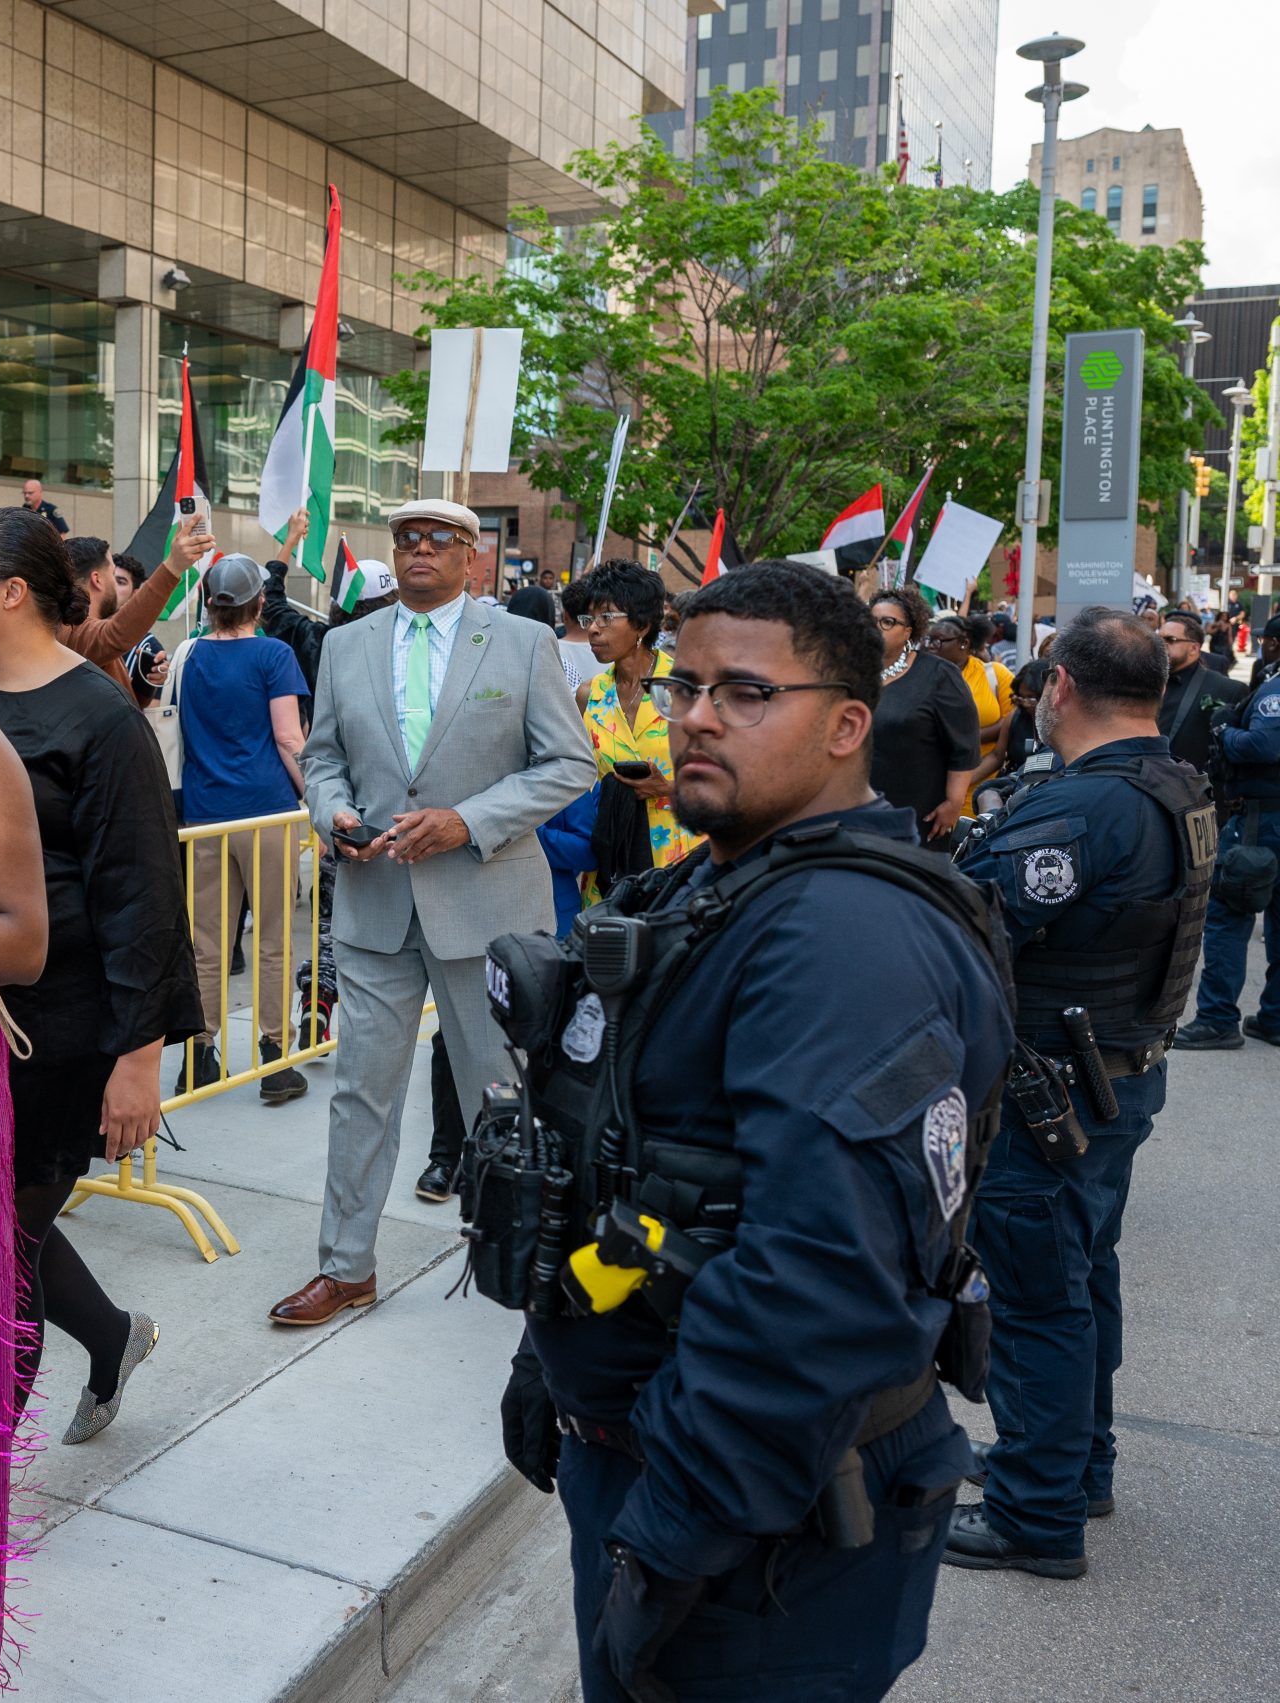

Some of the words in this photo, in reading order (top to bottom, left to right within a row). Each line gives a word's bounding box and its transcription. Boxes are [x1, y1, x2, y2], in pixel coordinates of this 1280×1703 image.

[1084, 397, 1097, 446] PLACE
[1099, 396, 1114, 503] HUNTINGTON
[1066, 561, 1123, 569] WASHINGTON
[1068, 569, 1120, 578] BOULEVARD
[1078, 577, 1109, 585] NORTH
[1024, 848, 1050, 865] DETROIT
[1050, 848, 1073, 863] POLICE
[1024, 885, 1045, 903] MOBILE
[1045, 896, 1063, 904] FIELD
[1062, 882, 1078, 900] FORCE
